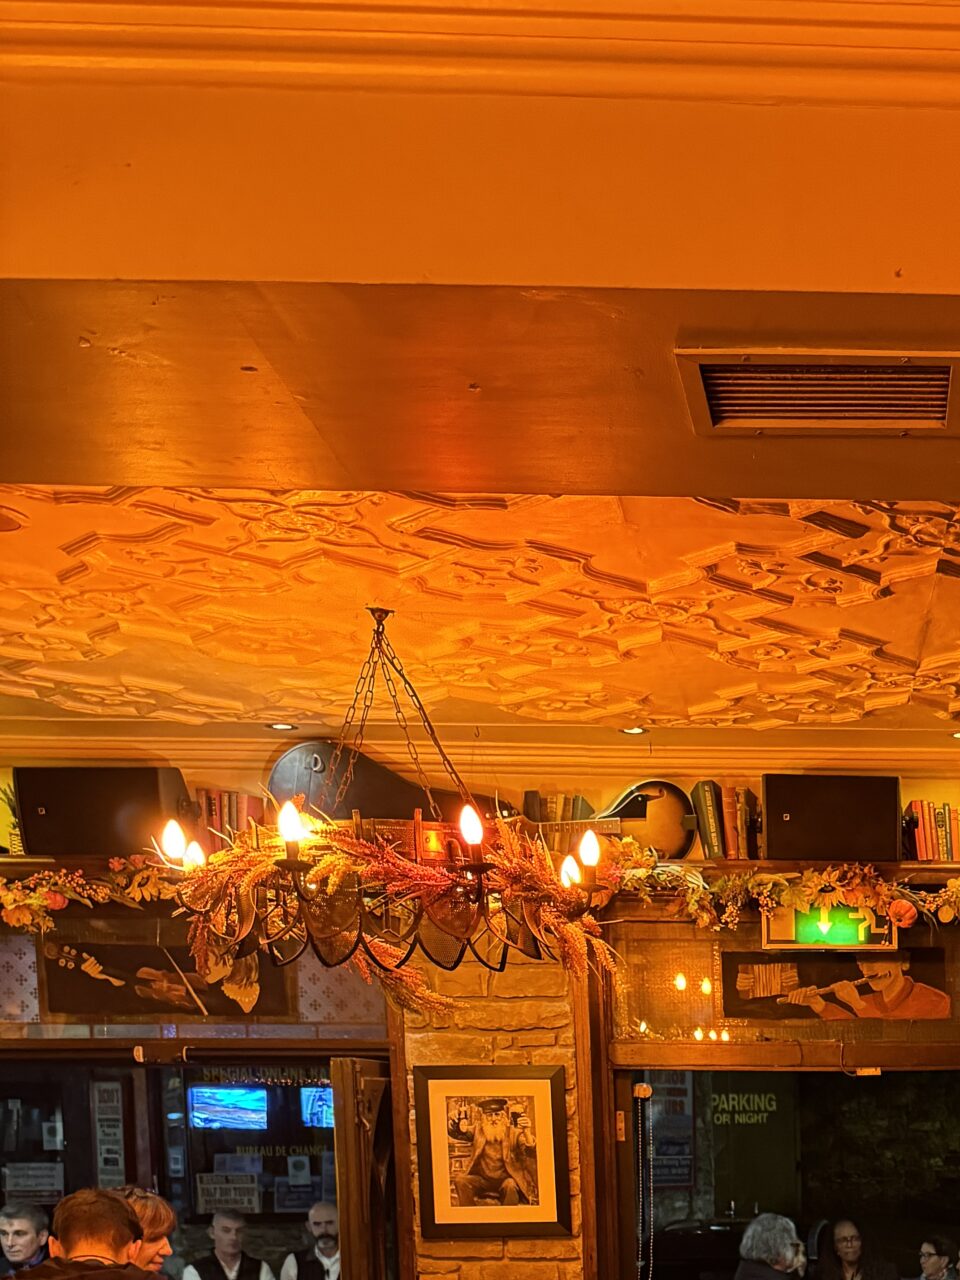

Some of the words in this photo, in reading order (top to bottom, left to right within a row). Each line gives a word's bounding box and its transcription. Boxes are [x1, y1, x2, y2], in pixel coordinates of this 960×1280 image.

[711, 1093, 777, 1112] PARKING
[714, 1113, 731, 1125] OR
[734, 1112, 769, 1124] NIGHT
[236, 1144, 273, 1157] BUREAU
[275, 1144, 287, 1157] DE
